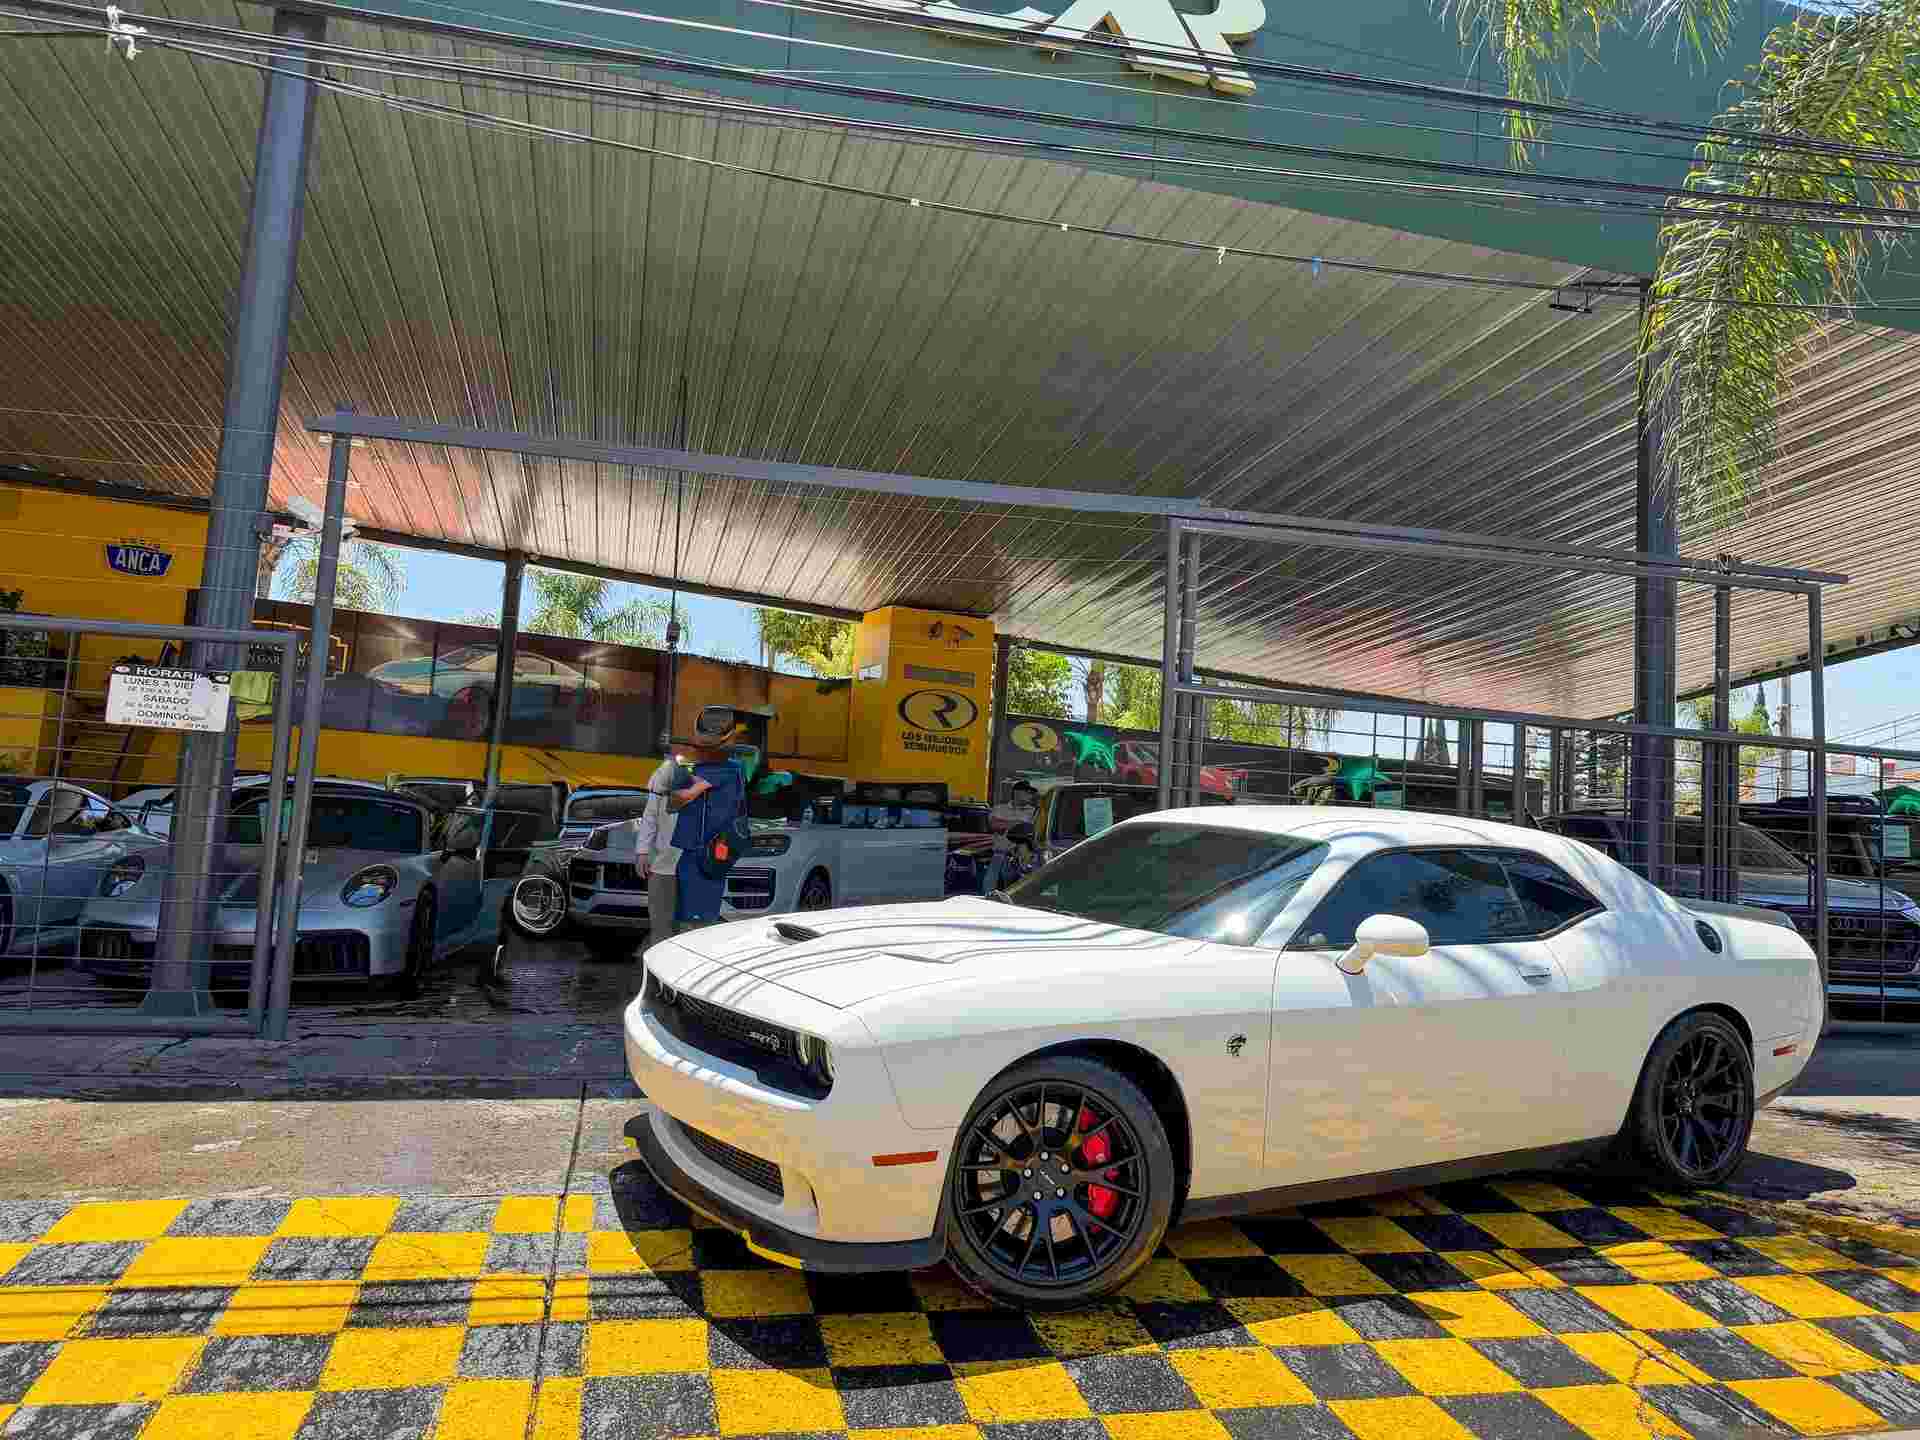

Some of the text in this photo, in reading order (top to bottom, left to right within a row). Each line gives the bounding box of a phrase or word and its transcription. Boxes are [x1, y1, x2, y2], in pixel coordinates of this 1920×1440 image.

[115, 549, 161, 571] ANCA
[136, 667, 204, 681] HORARI
[123, 676, 160, 687] LUNES
[137, 709, 192, 721] DOMINGO
